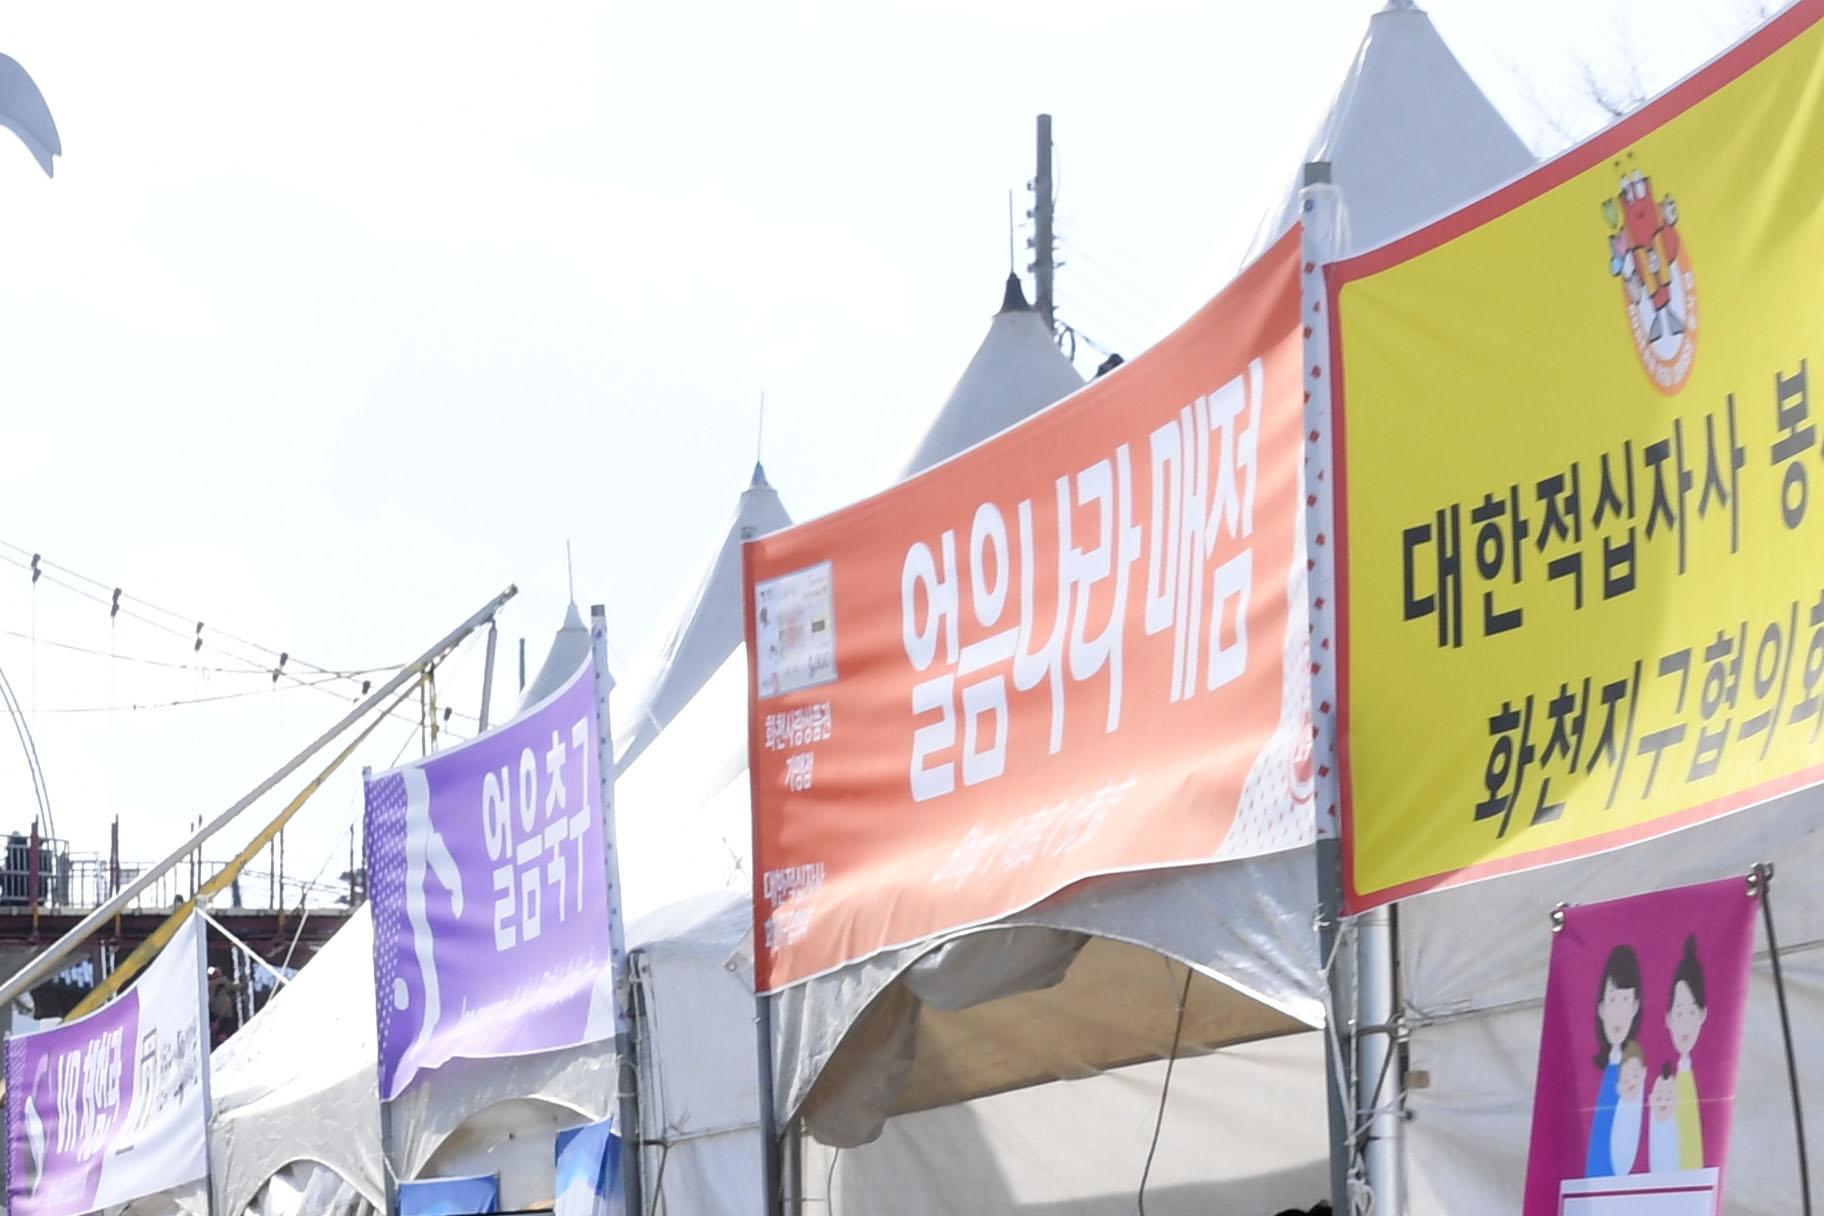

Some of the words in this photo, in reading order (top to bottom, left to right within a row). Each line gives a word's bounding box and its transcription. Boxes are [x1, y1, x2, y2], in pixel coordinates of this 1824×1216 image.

[902, 443, 1142, 802] 얼음나라
[1145, 358, 1264, 705] 매점
[1403, 393, 1746, 649] 대한적십자사
[1771, 357, 1824, 529] 봉
[482, 717, 591, 951] 얼음축구
